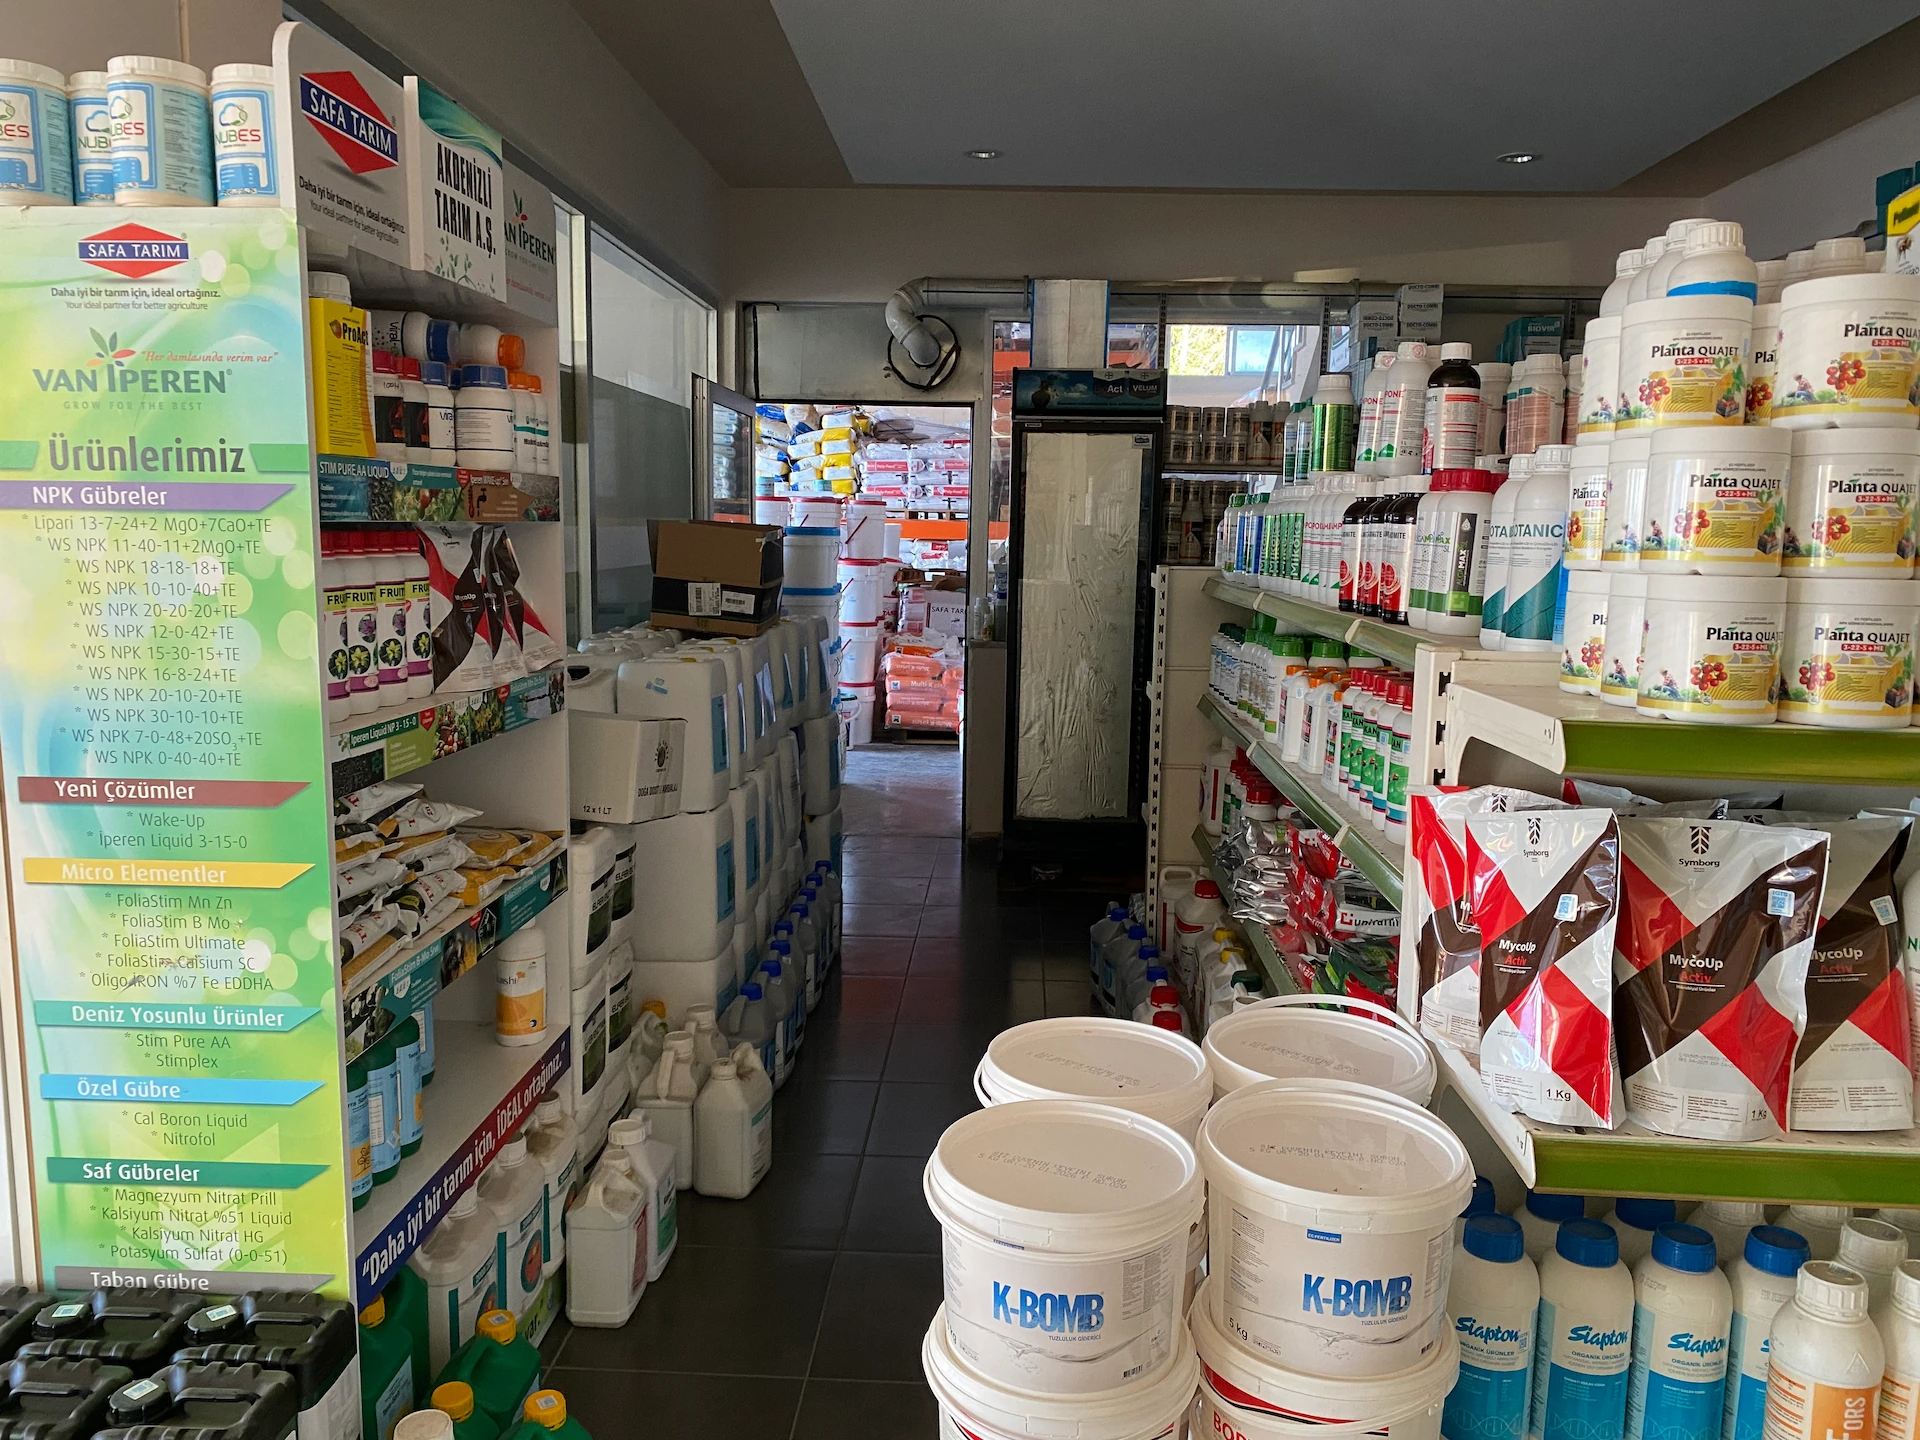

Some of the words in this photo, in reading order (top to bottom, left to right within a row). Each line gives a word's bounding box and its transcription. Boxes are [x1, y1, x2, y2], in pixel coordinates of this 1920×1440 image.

[310, 87, 346, 130] SAFA
[350, 110, 392, 156] TARIM
[436, 142, 492, 210] AKDENİZLİ
[434, 188, 472, 244] TARIM
[475, 210, 496, 259] A.Ş.
[504, 221, 517, 245] AN
[88, 243, 126, 258] SAFA
[131, 244, 181, 258] TARIM
[51, 288, 76, 297] Daha
[77, 288, 88, 300] iyi
[89, 288, 103, 297] bir
[151, 289, 175, 298] ideal
[65, 301, 81, 309] Your
[82, 301, 102, 310] ideal
[103, 301, 131, 312] partner
[131, 301, 142, 310] for
[143, 301, 167, 310] better
[167, 301, 208, 312] agriculture
[342, 322, 369, 346] ProAct
[1844, 321, 1893, 338] Planta
[226, 352, 253, 362] verim
[1651, 343, 1695, 358] Planta
[1698, 346, 1739, 358] QUAJET
[32, 369, 97, 392] VAN
[1133, 384, 1158, 392] VELUM
[63, 401, 100, 410] GROW
[109, 401, 133, 410] FOR
[139, 401, 164, 410] THE
[172, 401, 202, 411] BEST
[49, 433, 245, 473] Ürünlerimiz
[319, 461, 337, 474] STIM
[337, 463, 356, 476] PURE
[356, 465, 367, 477] AA
[367, 466, 389, 479] LIQUID
[1690, 473, 1738, 489] Planta
[1741, 478, 1782, 490] QUAJET
[1828, 479, 1877, 494] Planta
[1881, 483, 1917, 495] QUAJET
[32, 486, 74, 505] NPK
[80, 486, 167, 505] Gübreler
[1573, 487, 1600, 499] Planta
[35, 515, 74, 532] Lipari
[80, 517, 158, 531] 13-7-24+2
[163, 517, 272, 535] MgO+7CaO+TE
[48, 537, 71, 552] WS
[77, 538, 107, 552] NPK
[113, 539, 261, 558] 11-40-11+2MgO+TE
[1706, 627, 1753, 642] Planta
[1814, 627, 1864, 643] Planta
[1868, 632, 1910, 645] QUAJET
[72, 729, 95, 742] WS
[100, 729, 130, 743] NPK
[54, 780, 97, 798] Yeni
[104, 780, 195, 801] Çözümler
[583, 804, 590, 814] 12
[602, 806, 612, 815] LT
[139, 813, 205, 830] Wake-Up
[99, 831, 146, 848] İperen
[150, 833, 193, 850] Liquid
[198, 835, 248, 849] 3-15-0
[1523, 849, 1549, 857] Symborg
[1678, 858, 1720, 868] Symborg
[61, 864, 114, 880] Micro
[121, 864, 226, 883] Elementler
[117, 893, 182, 908] FoliaStim
[188, 896, 210, 909] Mn
[215, 896, 232, 910] Zn
[1499, 939, 1537, 954] MycoUp
[1505, 955, 1527, 966] Activ
[1669, 953, 1724, 971] MycoUp
[1820, 964, 1853, 975] Activ
[91, 973, 128, 990] Oligo
[173, 975, 197, 989] %7
[203, 976, 219, 989] Fe
[224, 976, 274, 991] EDDHA
[1679, 971, 1712, 984] Activ
[72, 1005, 125, 1023] Deniz
[131, 1007, 206, 1025] Yosunlu
[213, 1007, 284, 1027] Ürünler
[156, 1054, 218, 1071] Stimplex
[77, 1076, 118, 1097] Özel
[124, 1080, 181, 1098] Gübre
[1546, 1088, 1551, 1097] 1
[1555, 1089, 1571, 1102] Kg
[163, 1132, 216, 1146] Nitrofol
[82, 1163, 112, 1180] Saf
[118, 1163, 200, 1182] Gübreler
[406, 1201, 423, 1244] iyi
[424, 1187, 443, 1223] bir
[442, 1153, 473, 1201] tarım
[474, 1131, 496, 1167] için,
[497, 1095, 523, 1139] İDEAL
[115, 1189, 201, 1206] Magnezyum
[206, 1191, 245, 1205] Nitrat
[251, 1192, 277, 1206] Prill
[90, 1271, 147, 1289] Taban
[153, 1273, 209, 1291] Gübre
[1302, 1273, 1412, 1318] K-BOMB
[993, 1280, 1105, 1333] K-BOMB
[1229, 1317, 1235, 1329] 5
[1236, 1321, 1248, 1342] kg
[1455, 1316, 1519, 1345] Siapton
[1568, 1325, 1628, 1351] Siapton
[1667, 1332, 1727, 1357] Siapton
